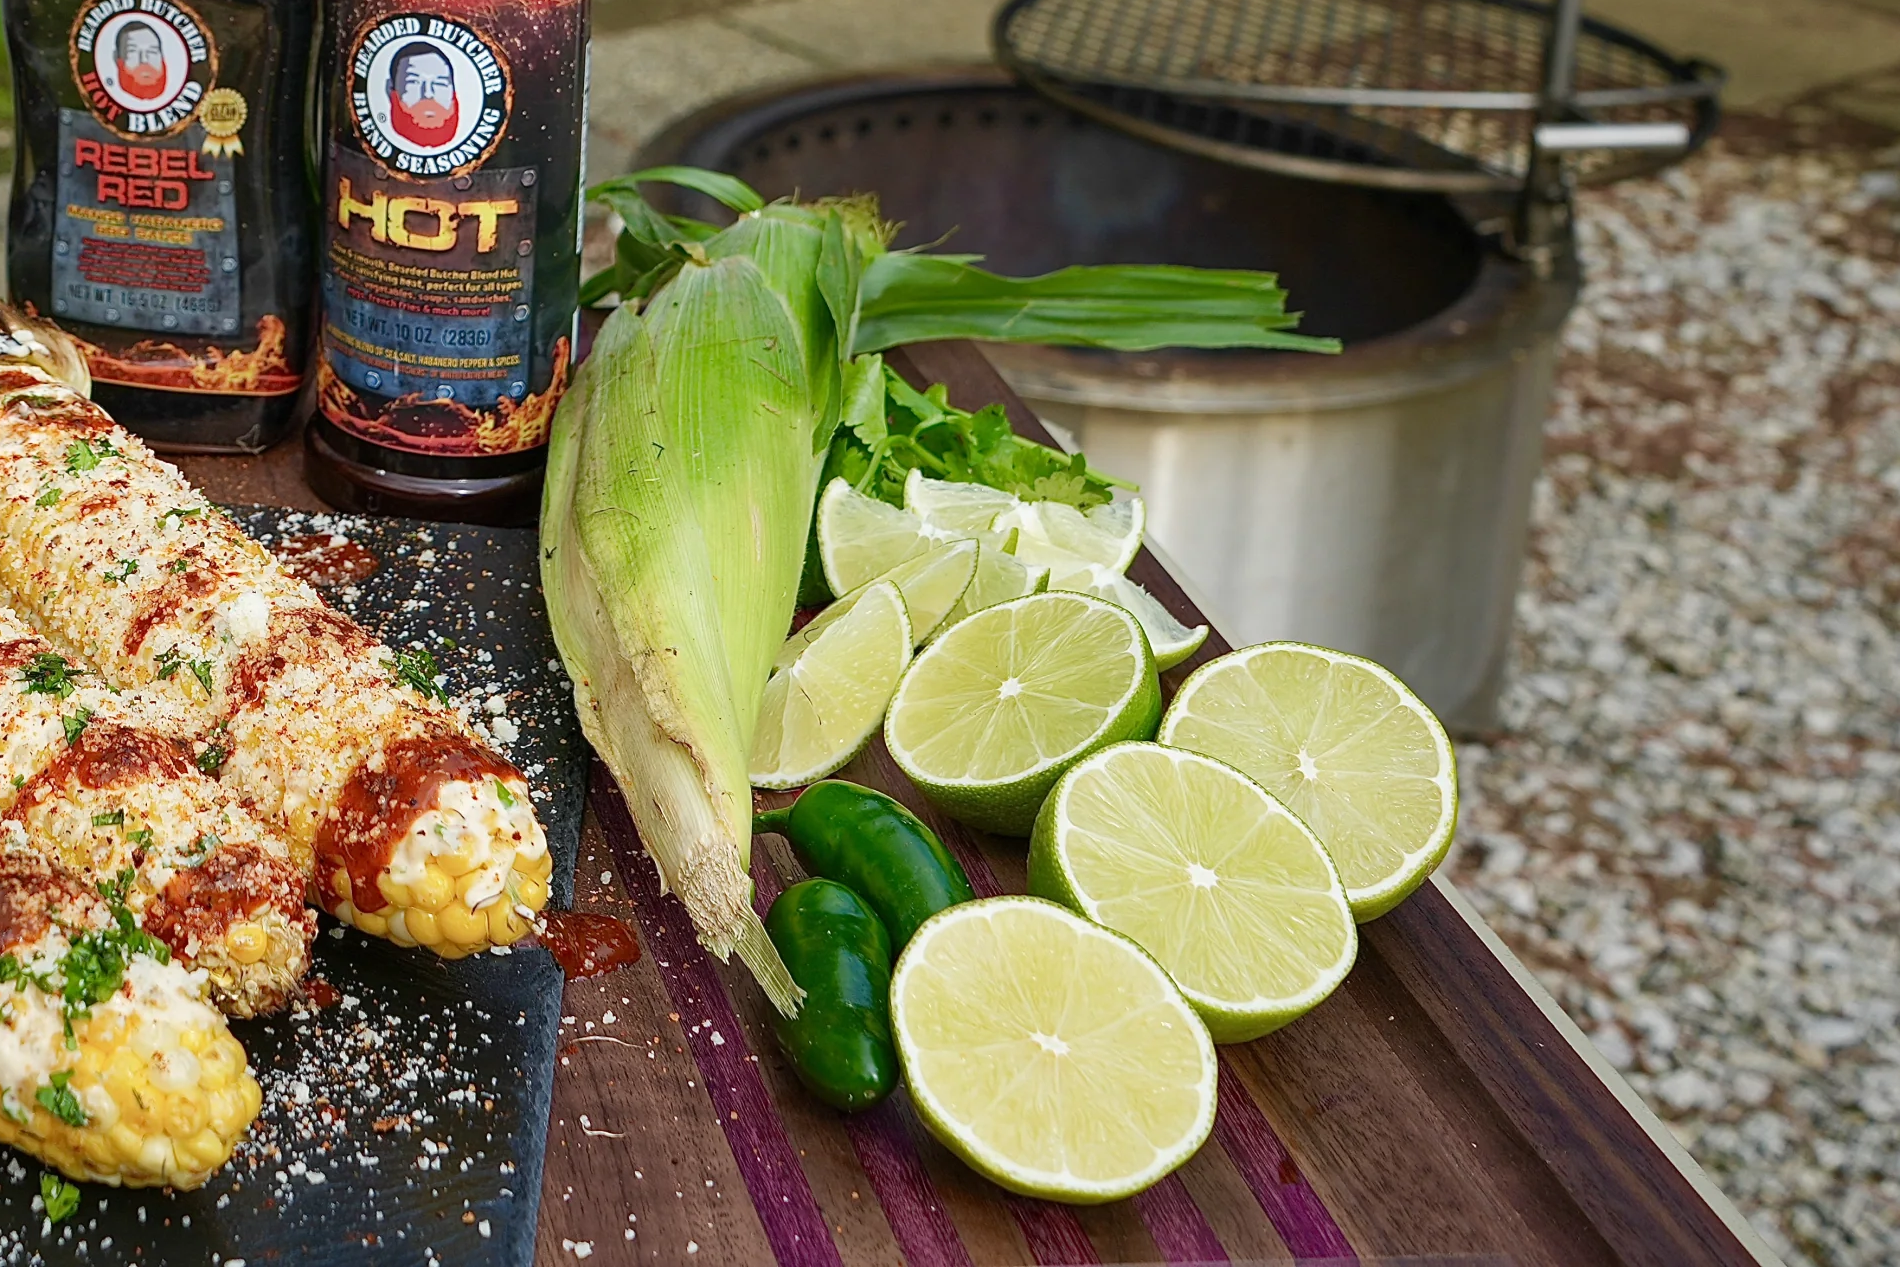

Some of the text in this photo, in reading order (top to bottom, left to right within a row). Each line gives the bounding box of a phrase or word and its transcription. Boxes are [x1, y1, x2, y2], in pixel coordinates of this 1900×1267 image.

[353, 16, 502, 96] BEARDED BUTCHER
[81, 71, 204, 133] HOT BLEND
[352, 91, 501, 175] BLEND SEASONING
[75, 138, 216, 181] REBEL
[96, 174, 190, 211] RED
[337, 175, 519, 254] HOT
[388, 261, 428, 278] Bearded
[430, 267, 469, 280] Butcher
[471, 268, 499, 280] Blend
[426, 281, 464, 293] perfect
[466, 281, 481, 292] for
[483, 281, 495, 292] all
[496, 280, 523, 293] types
[343, 307, 365, 329] NET
[367, 316, 390, 337] WT.
[394, 323, 410, 341] 10
[414, 325, 437, 345] OZ.
[432, 306, 460, 316] much
[461, 306, 491, 316] more!
[418, 355, 458, 368] HABANERO
[459, 357, 488, 369] PEPPER
